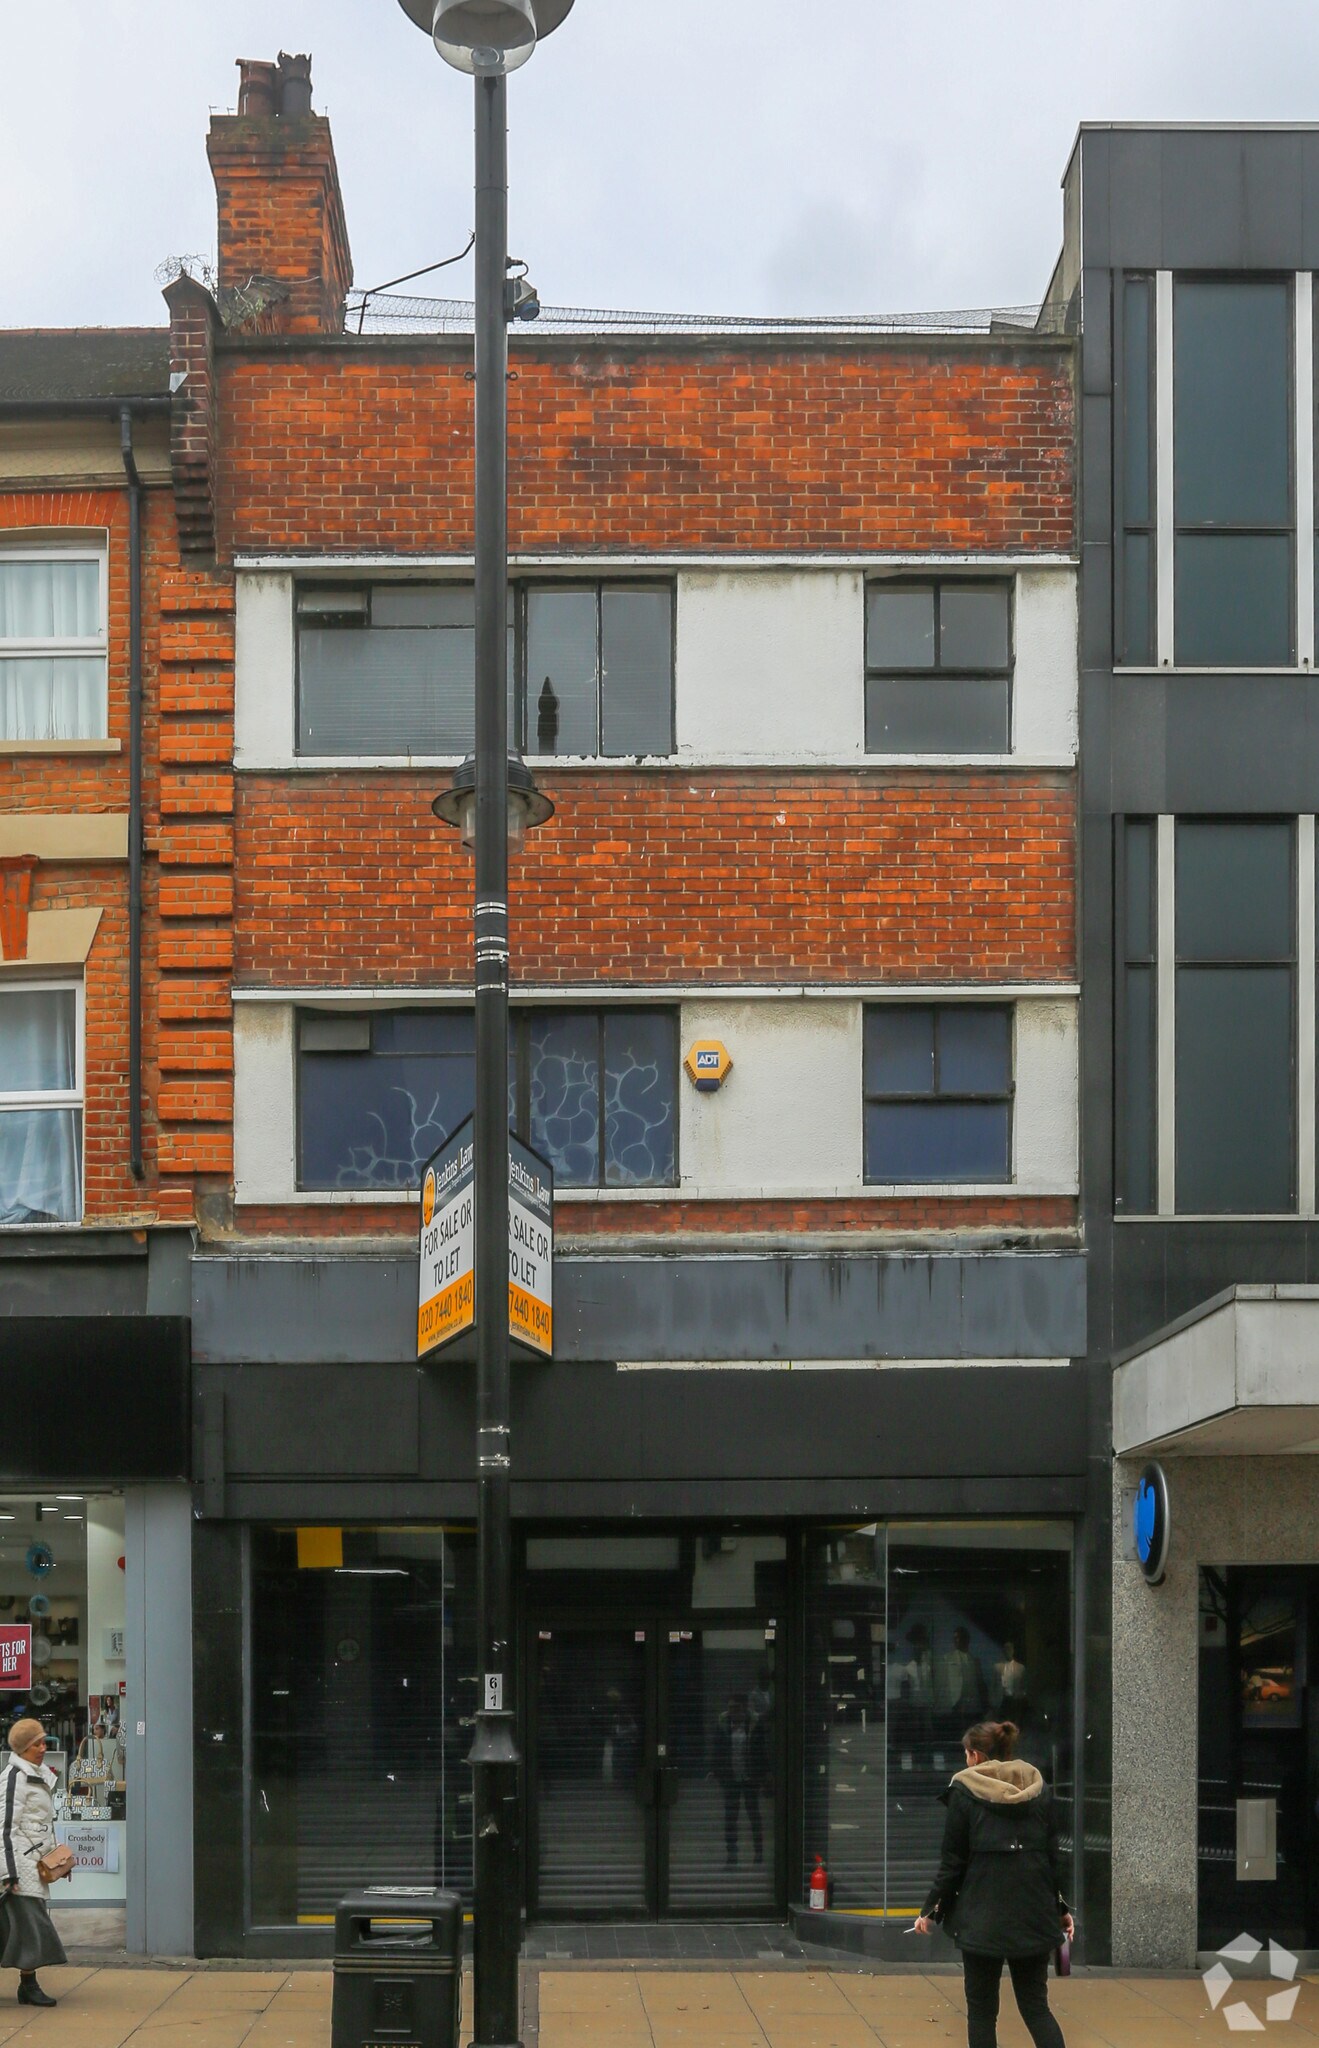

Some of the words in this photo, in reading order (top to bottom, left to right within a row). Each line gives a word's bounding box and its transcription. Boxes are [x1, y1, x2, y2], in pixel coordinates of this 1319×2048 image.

[698, 1054, 718, 1065] ADT
[436, 1158, 458, 1203] Jenkins
[460, 1143, 474, 1168] Law
[508, 1152, 534, 1192] Jenkins
[537, 1177, 550, 1205] Law
[424, 1228, 438, 1259] FOR
[441, 1210, 458, 1246] SALE
[461, 1198, 472, 1228] OR
[514, 1215, 534, 1251] SALE
[537, 1233, 548, 1262] OR
[434, 1260, 443, 1287] TO
[446, 1246, 460, 1279] LET
[521, 1258, 536, 1288] LET
[421, 1306, 432, 1334] 020
[435, 1294, 452, 1325] 7440
[455, 1280, 472, 1312] 1840
[509, 1290, 528, 1322] 7440
[532, 1304, 549, 1334] 1840
[12, 1640, 26, 1656] FOR
[3, 1657, 17, 1672] HER
[490, 1677, 497, 1689] 6
[491, 1695, 497, 1706] 1
[68, 1834, 105, 1843] Crossbody
[73, 1857, 103, 1866] 10.00
